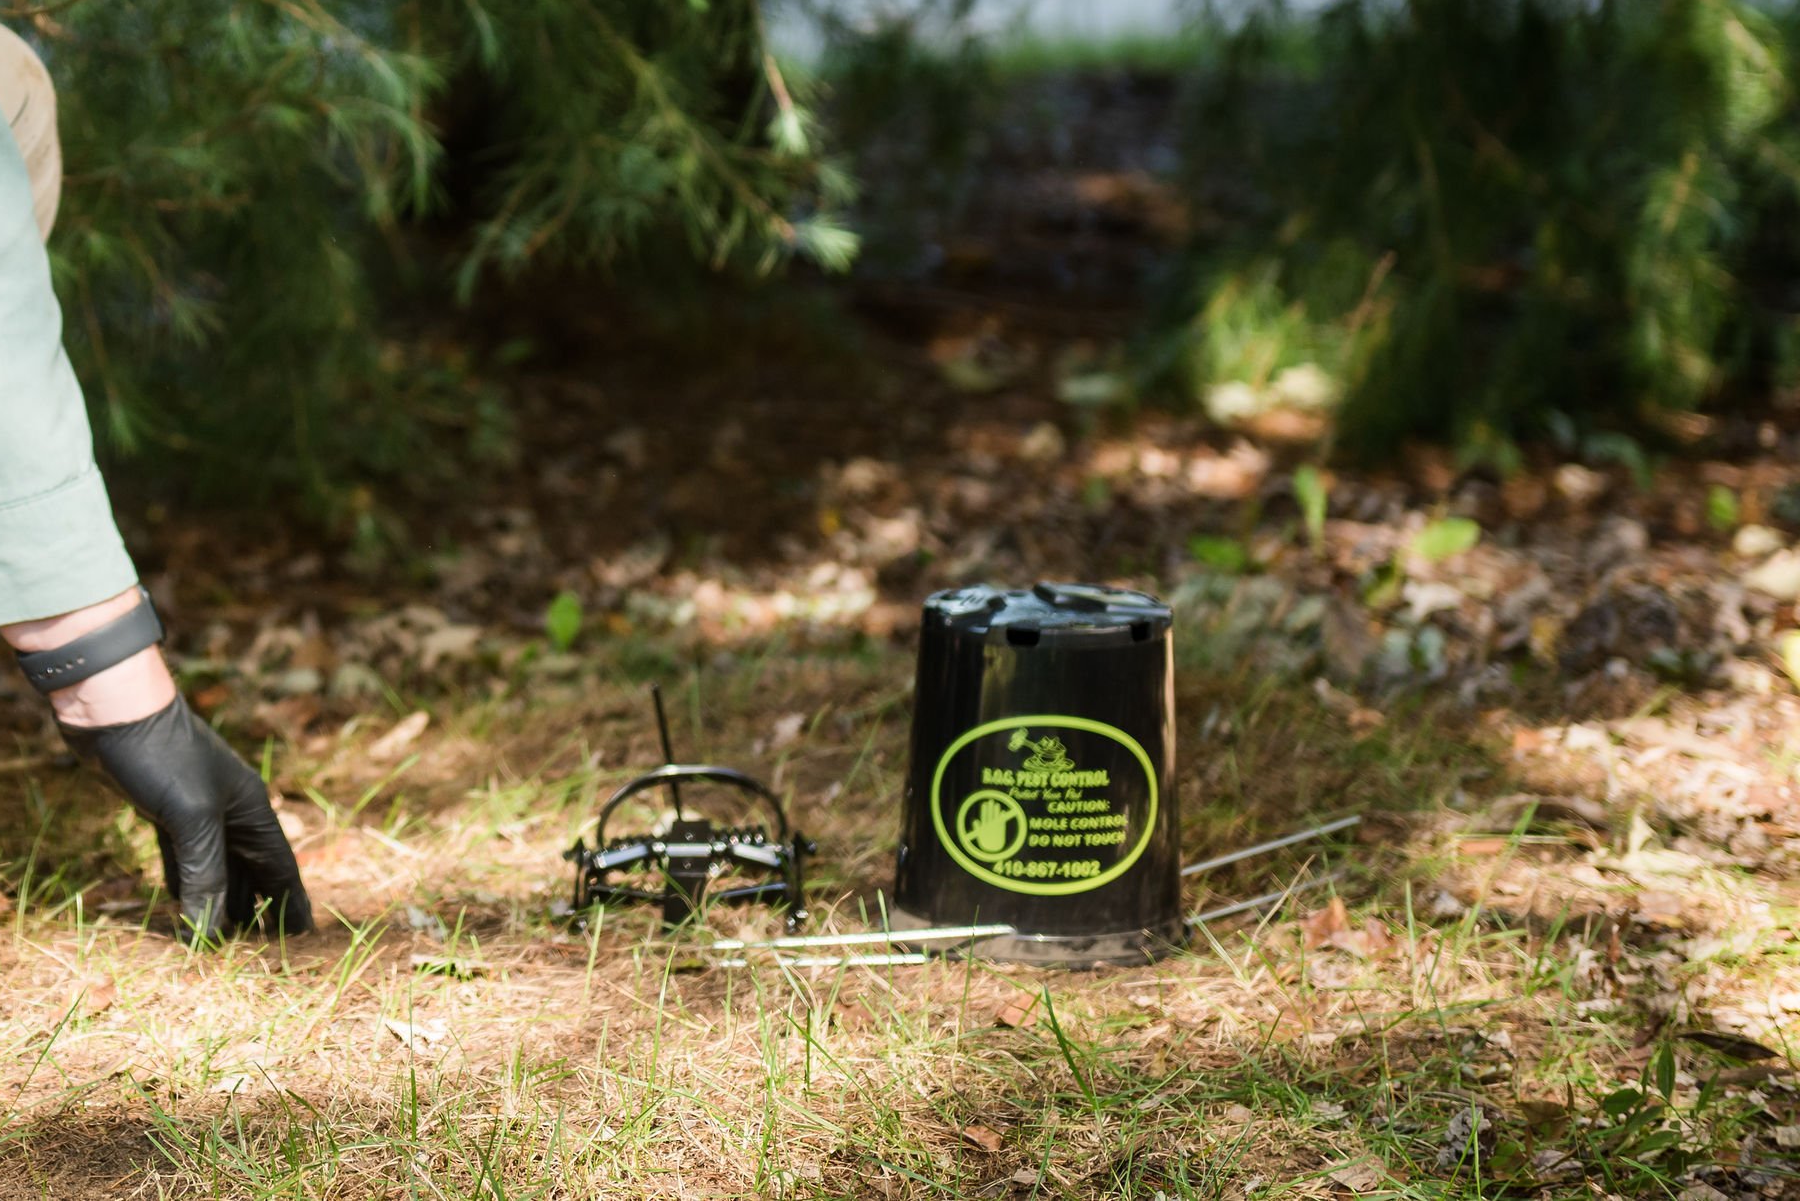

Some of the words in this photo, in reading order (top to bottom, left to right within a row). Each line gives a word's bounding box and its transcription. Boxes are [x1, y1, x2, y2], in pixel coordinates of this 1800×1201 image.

[1050, 770, 1110, 788] CONTROL
[1047, 800, 1111, 814] CAUTION:
[1029, 817, 1068, 830] MOLE
[1069, 814, 1129, 830] CONTROL
[1028, 834, 1051, 847] DO
[1052, 834, 1082, 847] NOT
[1083, 831, 1127, 846] TOUCH
